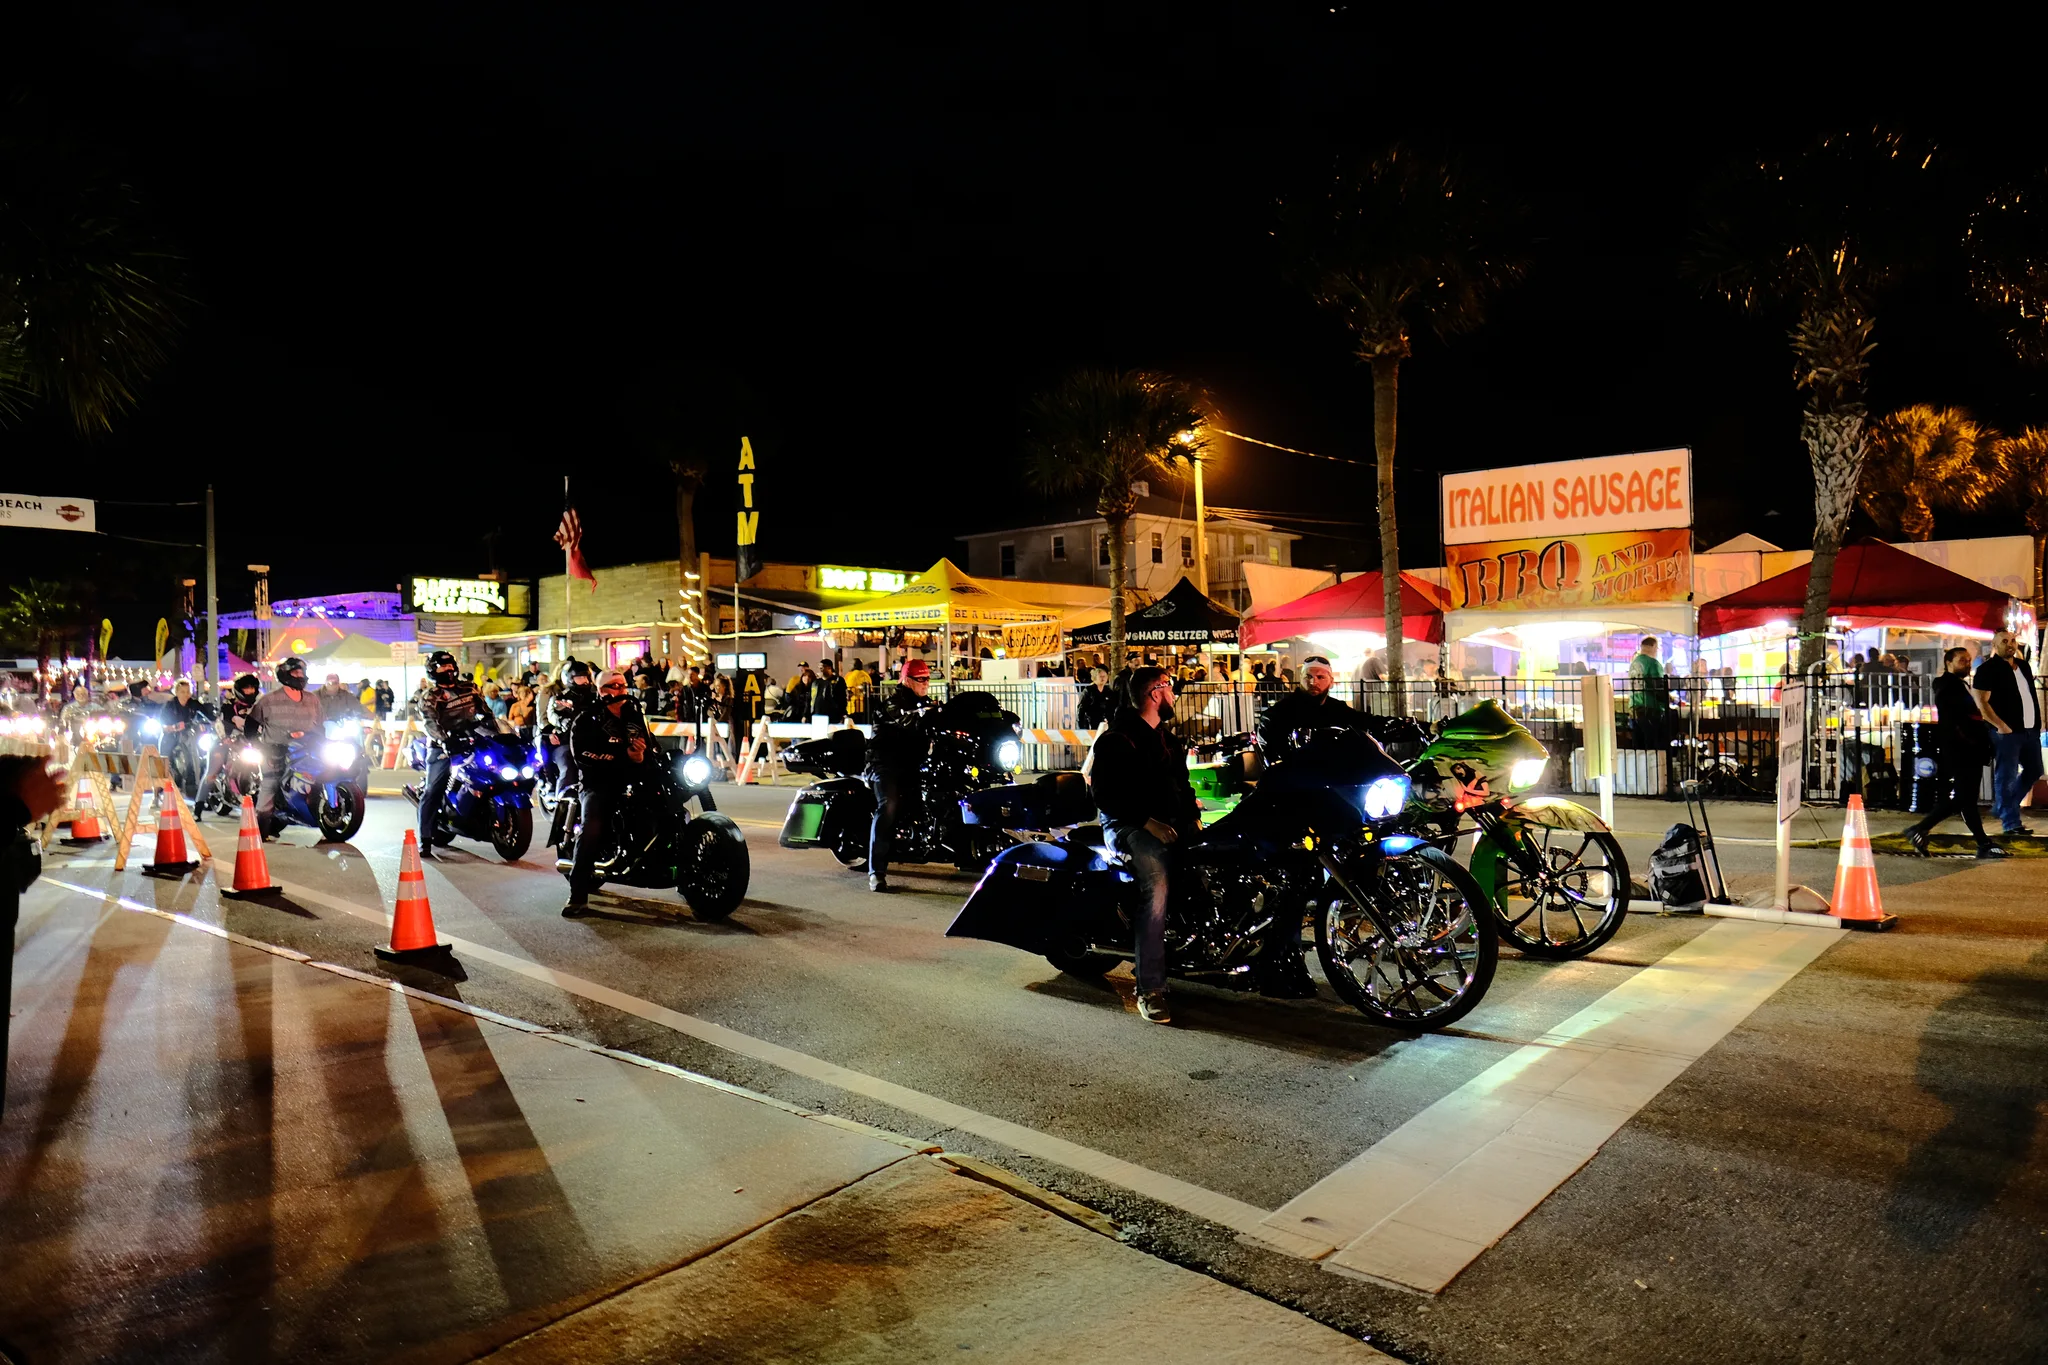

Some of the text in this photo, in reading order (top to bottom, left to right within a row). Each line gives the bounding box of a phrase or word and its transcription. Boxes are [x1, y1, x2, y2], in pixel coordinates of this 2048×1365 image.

[738, 436, 759, 545] ATM
[1449, 466, 1684, 529] ITALIAN SAUSAGE
[820, 567, 868, 590] BOOT
[1460, 541, 1581, 609] BBQ
[1592, 542, 1655, 577] AND
[1592, 551, 1683, 601] MORE!
[827, 609, 941, 623] BE A LITTLE TWISTED
[954, 609, 968, 618] BE
[971, 610, 979, 619] A
[983, 612, 1015, 620] LITTLE
[1074, 630, 1208, 643] WHITE CW HARD SELTZER
[744, 674, 762, 722] AT
